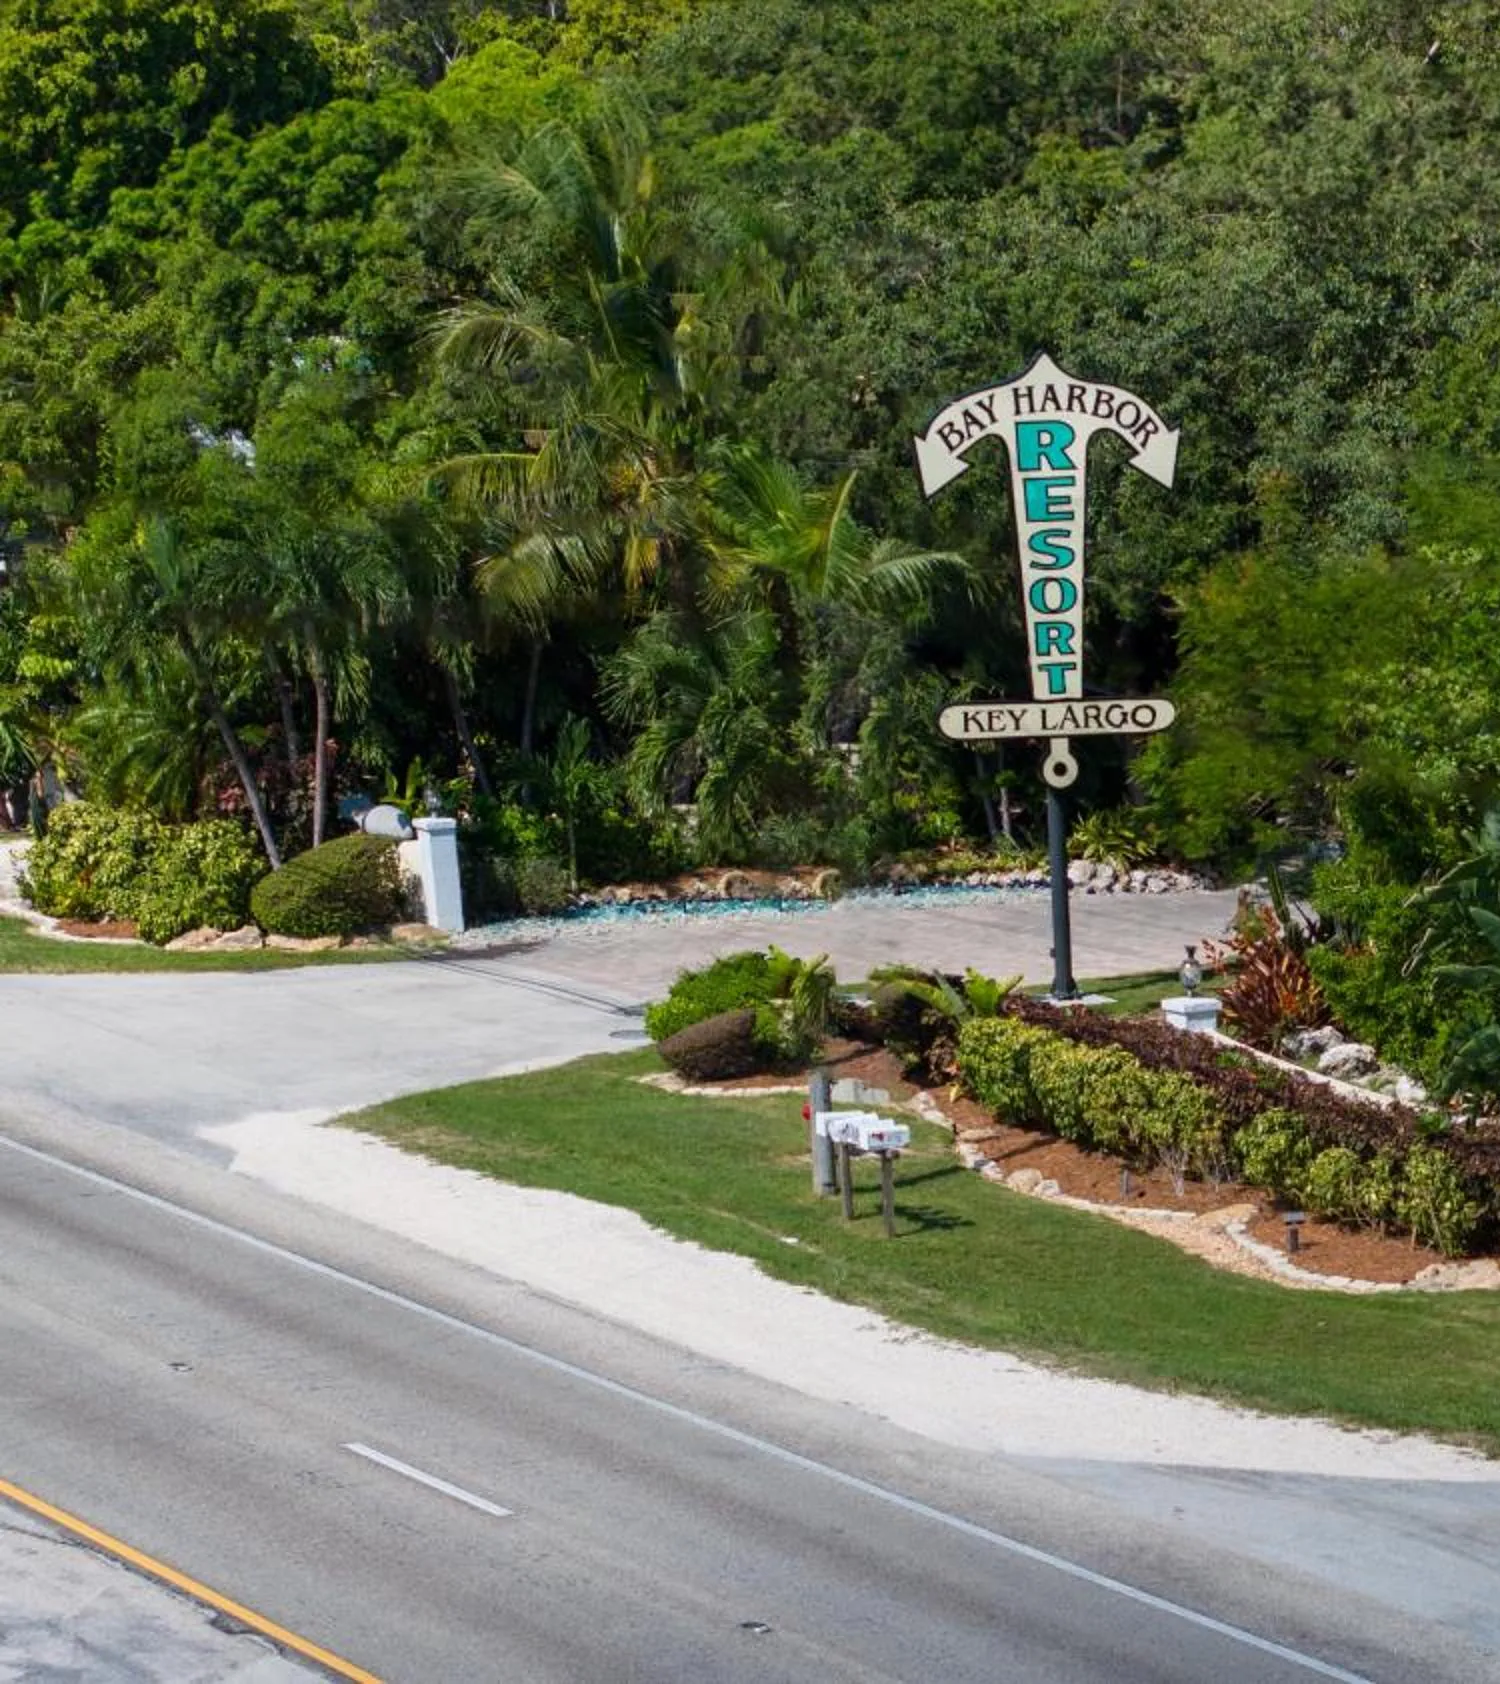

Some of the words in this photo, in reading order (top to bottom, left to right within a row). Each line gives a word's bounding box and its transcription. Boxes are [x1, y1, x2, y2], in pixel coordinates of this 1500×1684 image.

[937, 394, 998, 450] BAY
[1012, 384, 1158, 446] HARBOR
[1014, 420, 1077, 694] RESORT
[963, 709, 1027, 732] KEY
[1041, 704, 1157, 730] LARGO
